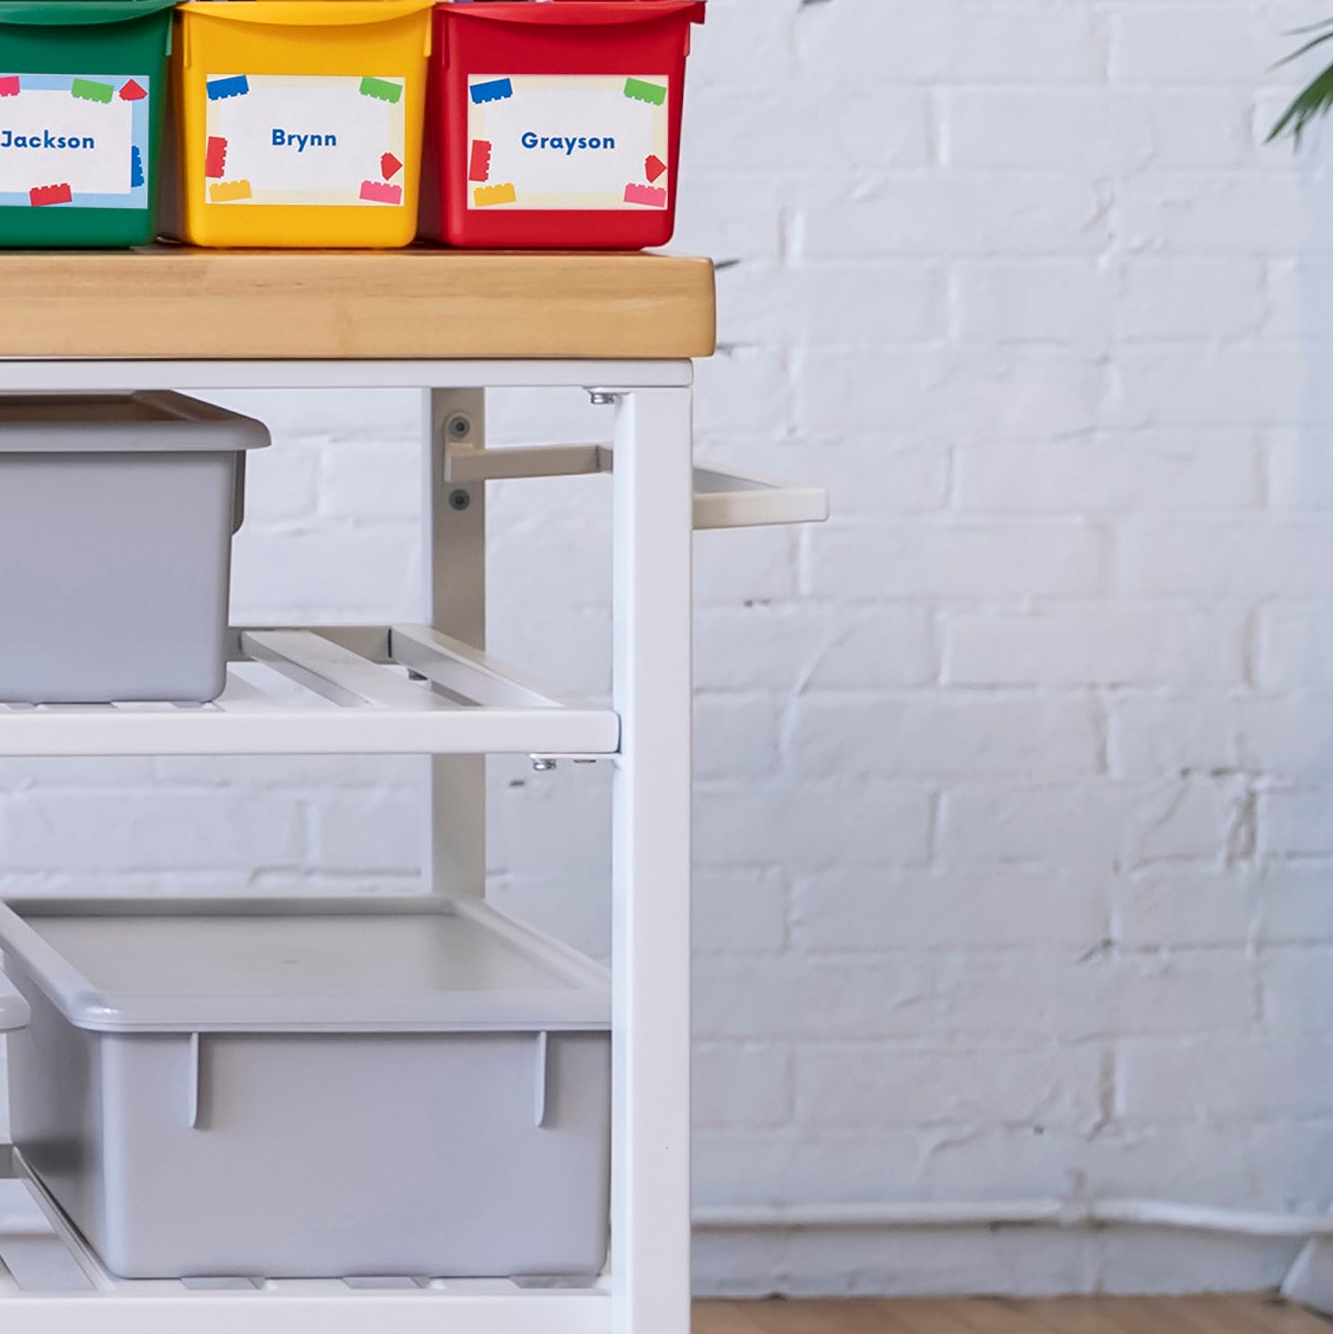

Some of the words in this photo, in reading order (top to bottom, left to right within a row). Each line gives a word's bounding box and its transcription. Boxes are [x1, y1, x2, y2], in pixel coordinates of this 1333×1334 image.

[0, 129, 95, 150] Jackson
[271, 128, 337, 153] Brynn
[520, 131, 616, 156] Grayson
